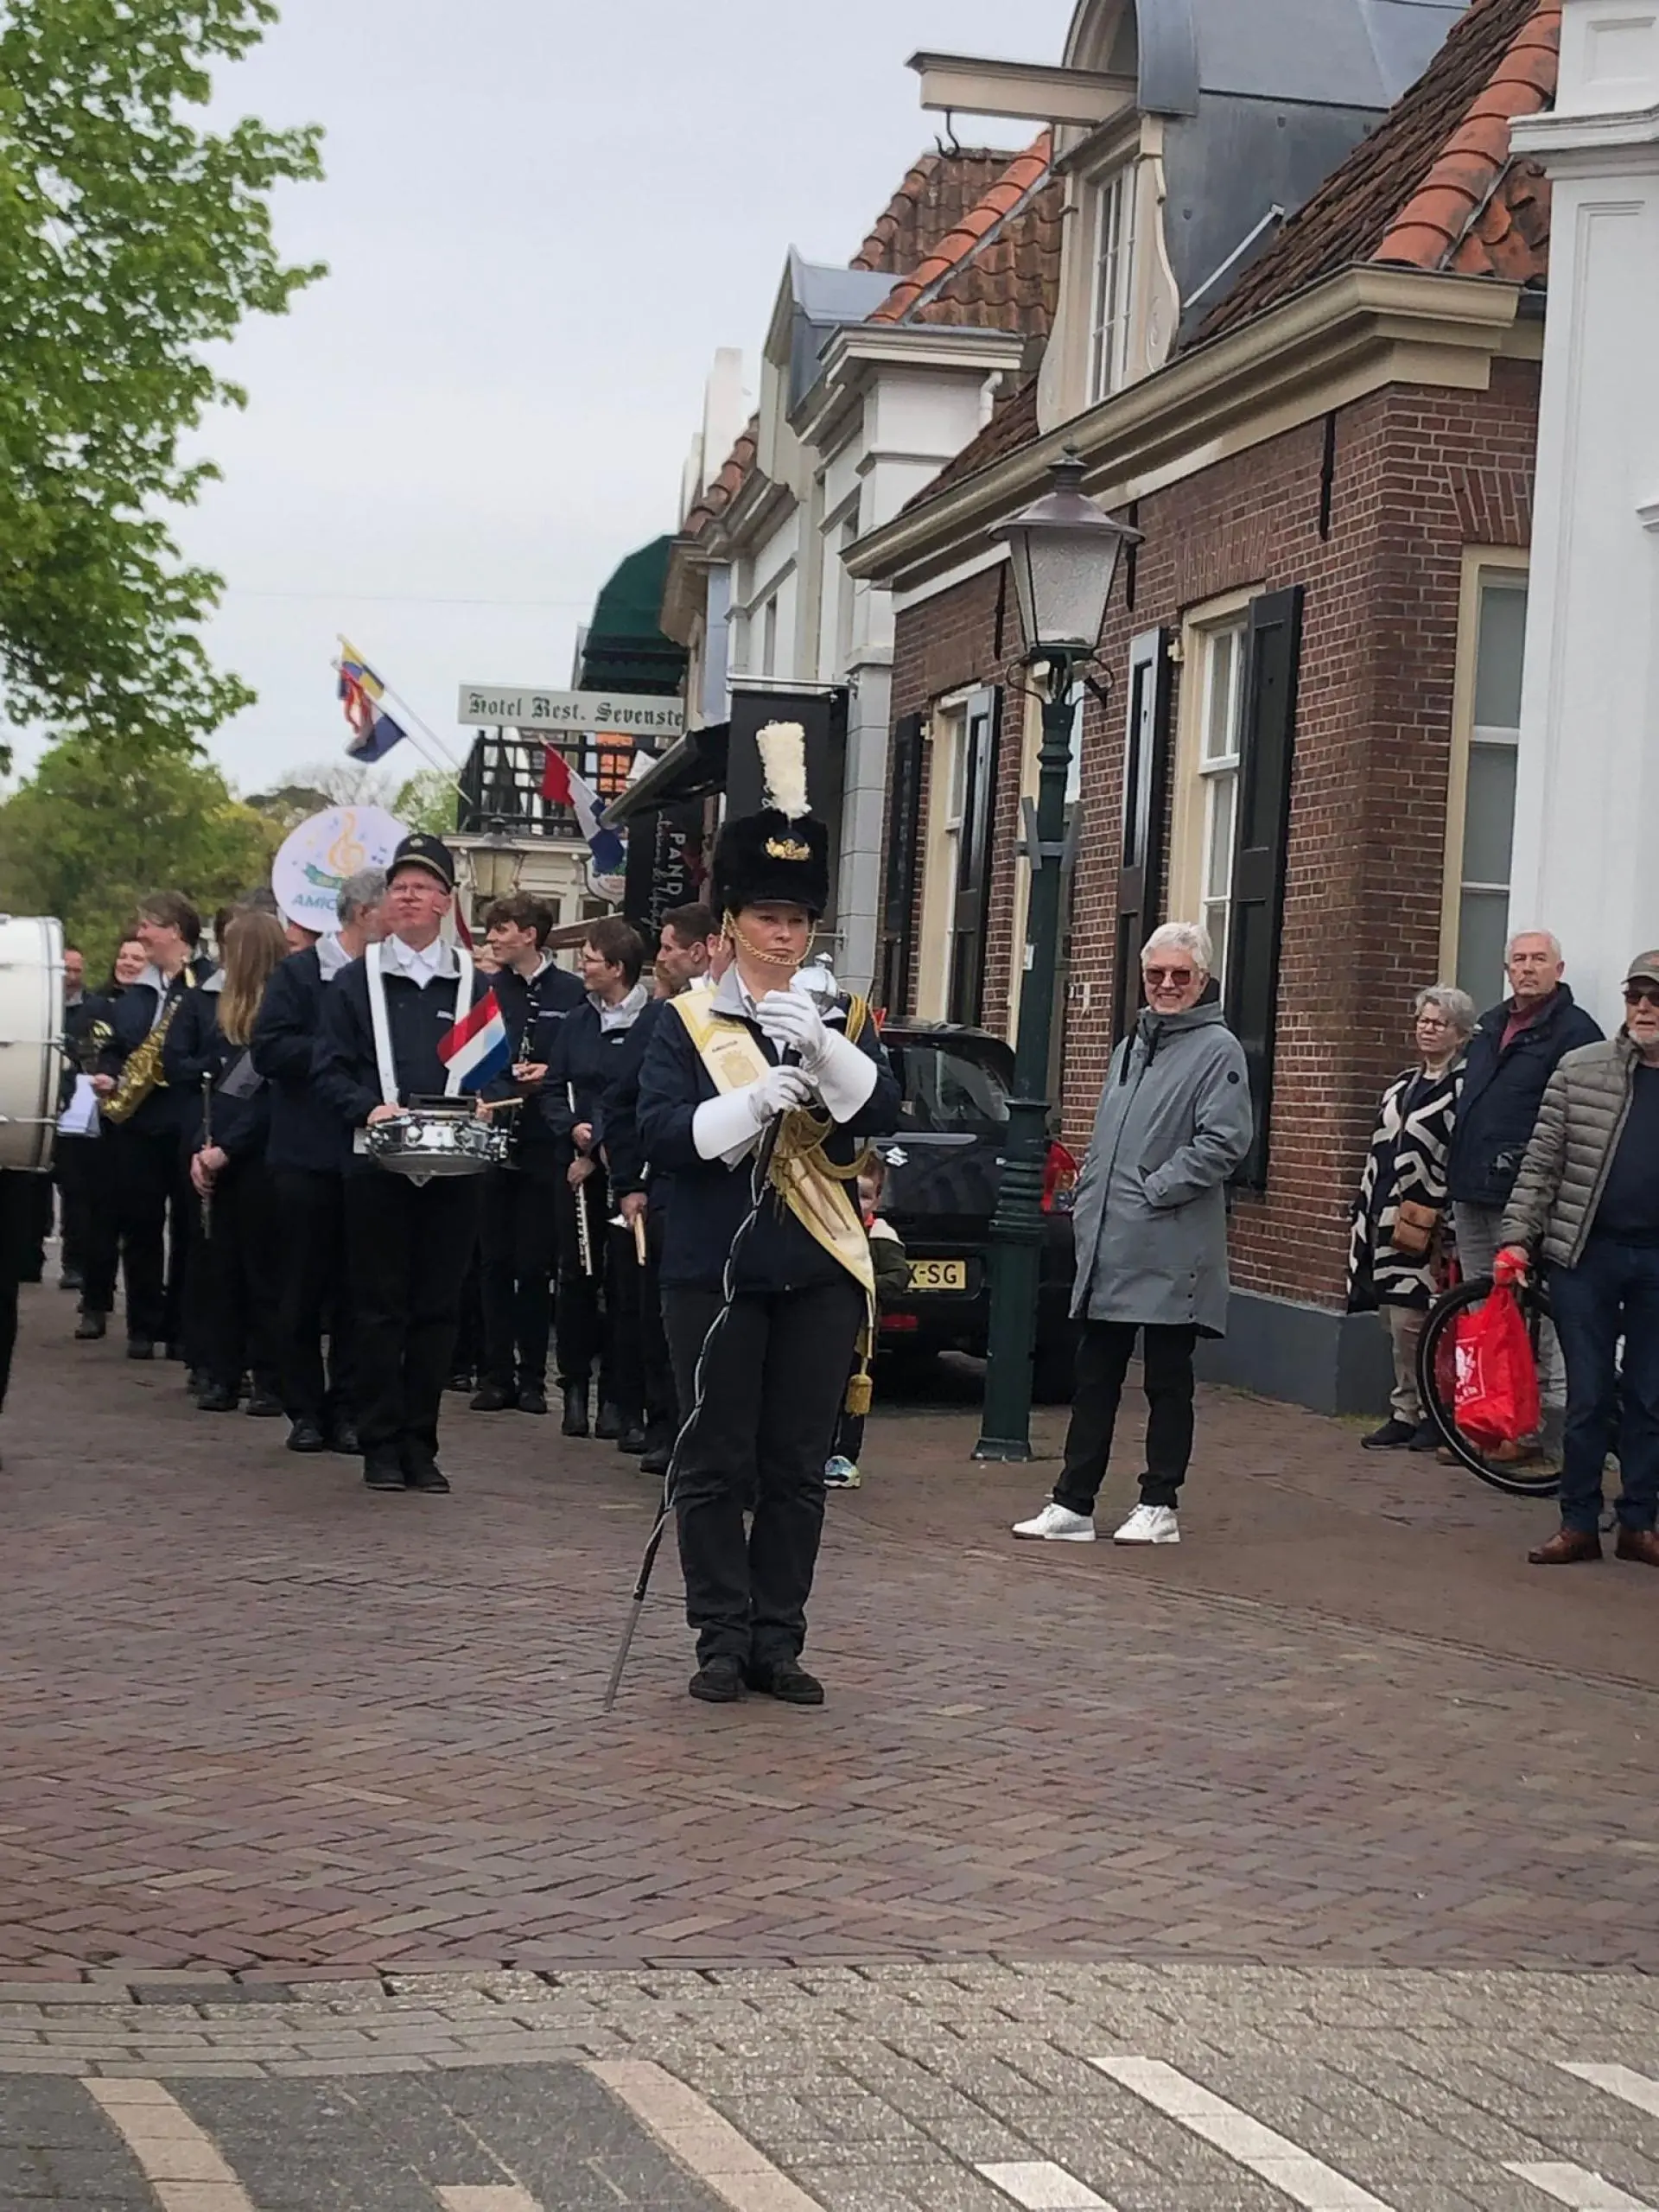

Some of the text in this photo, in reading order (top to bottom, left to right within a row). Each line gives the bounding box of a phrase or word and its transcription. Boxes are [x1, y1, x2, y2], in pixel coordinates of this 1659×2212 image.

[468, 692, 522, 716] Hotel
[531, 696, 587, 721] Rest.
[667, 833, 686, 895] PAND
